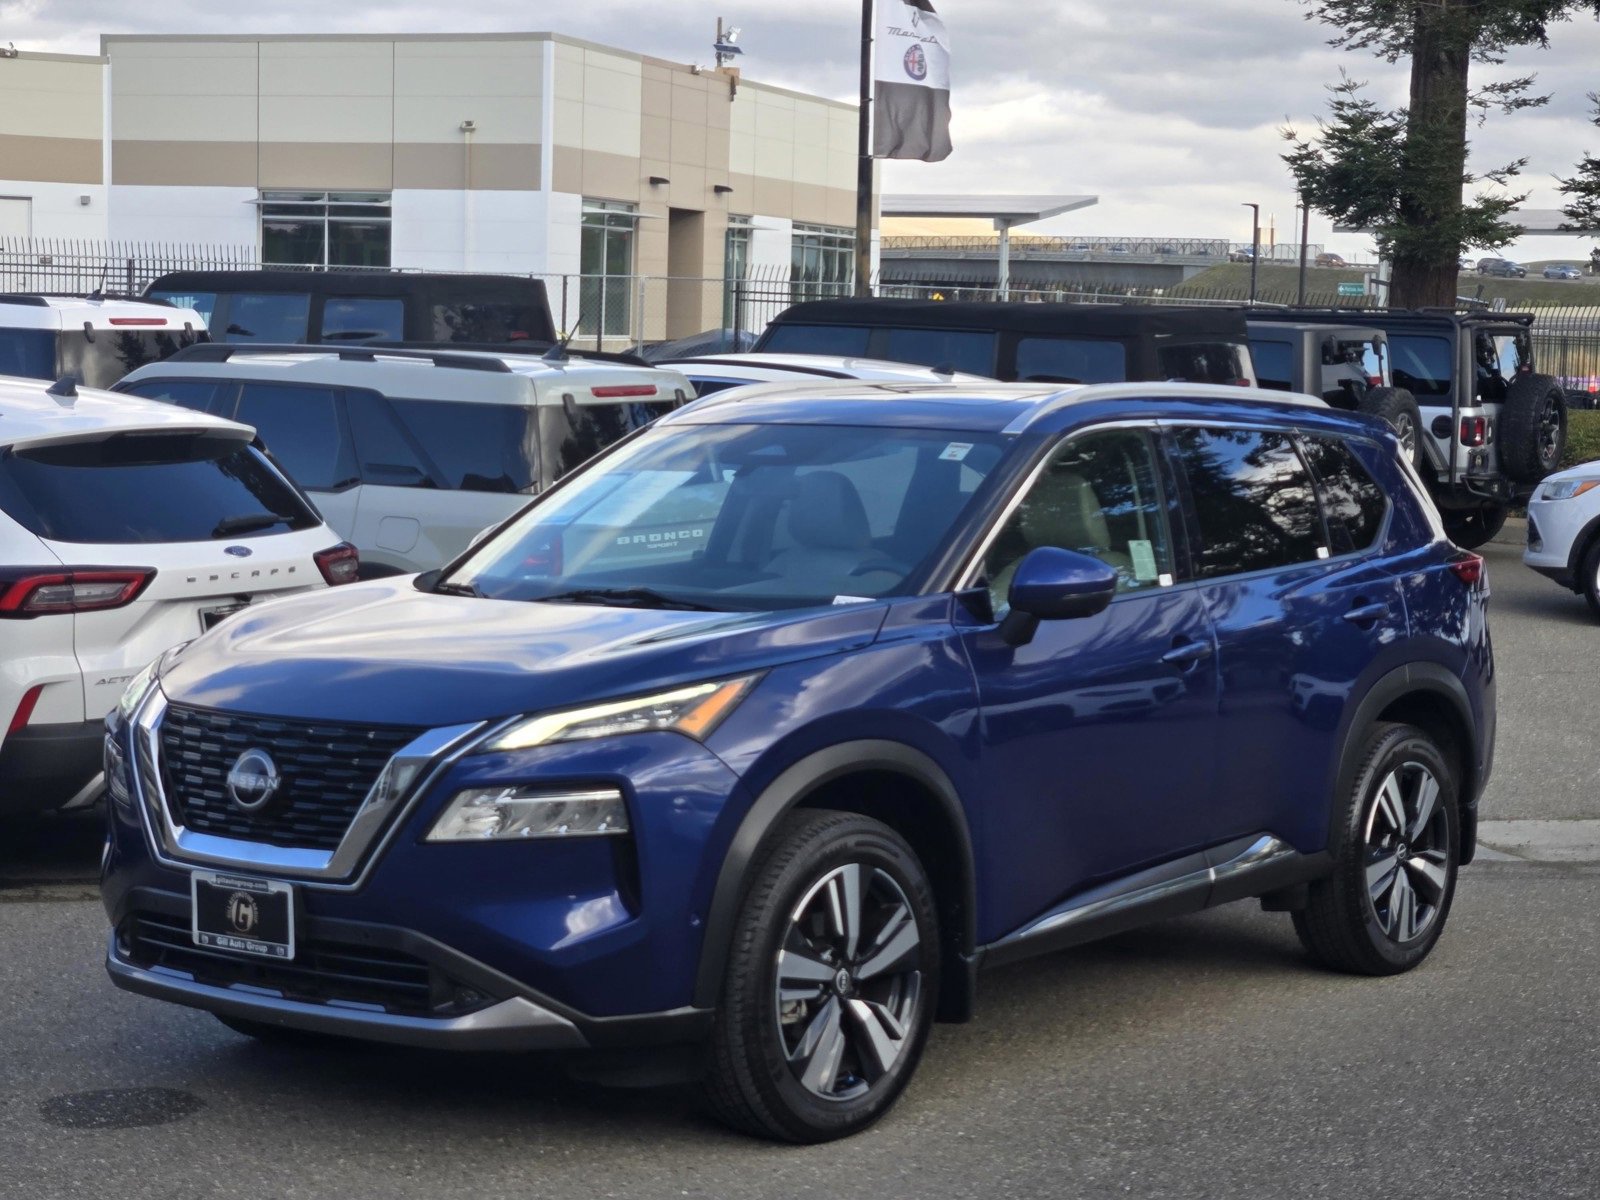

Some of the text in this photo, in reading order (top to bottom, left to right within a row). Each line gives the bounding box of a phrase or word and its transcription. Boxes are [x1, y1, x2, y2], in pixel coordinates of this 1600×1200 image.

[616, 529, 703, 545] BRONCO
[228, 773, 278, 788] NISSAN
[216, 937, 268, 953] Gill Auto Group
